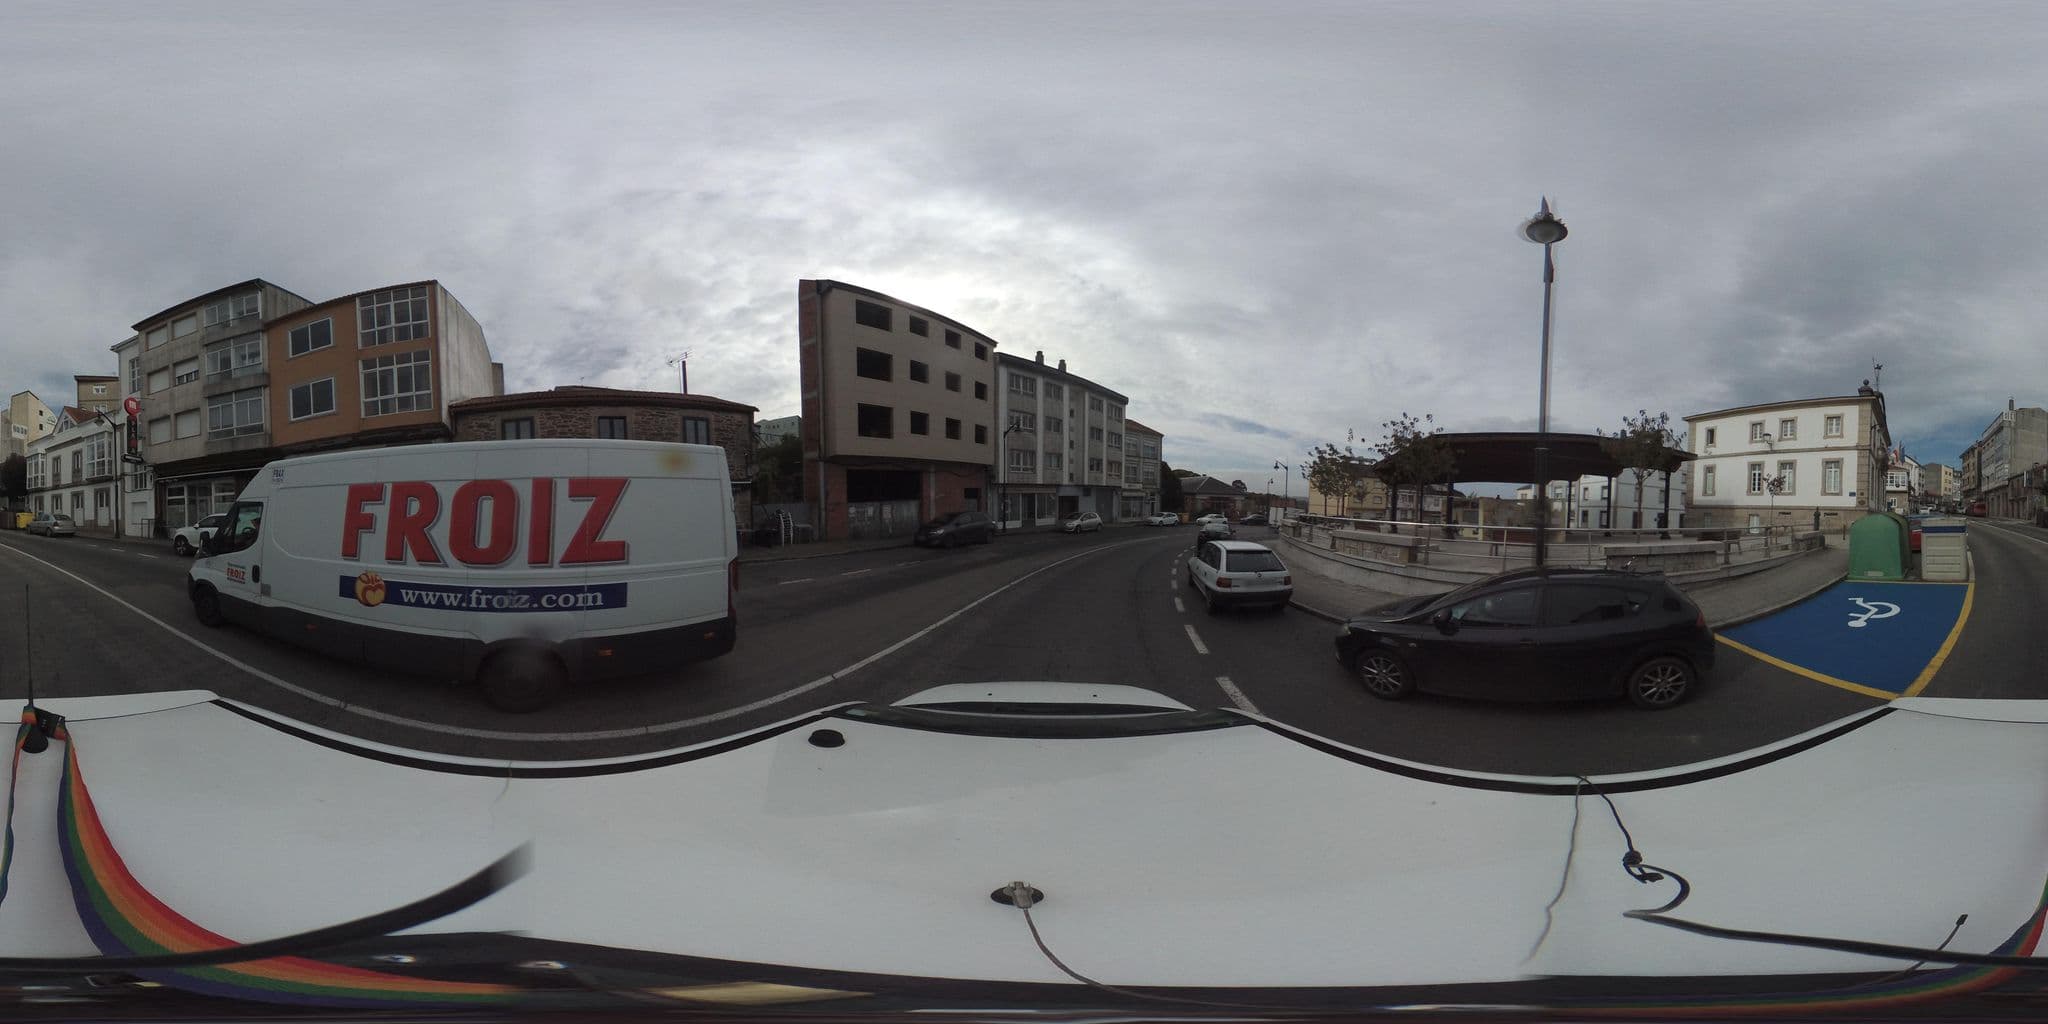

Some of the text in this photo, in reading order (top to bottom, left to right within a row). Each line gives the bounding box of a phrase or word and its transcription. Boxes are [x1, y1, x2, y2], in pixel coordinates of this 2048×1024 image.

[341, 477, 631, 567] FROIZ
[227, 567, 246, 580] FROIZ
[400, 588, 604, 609] www.froiz.com
